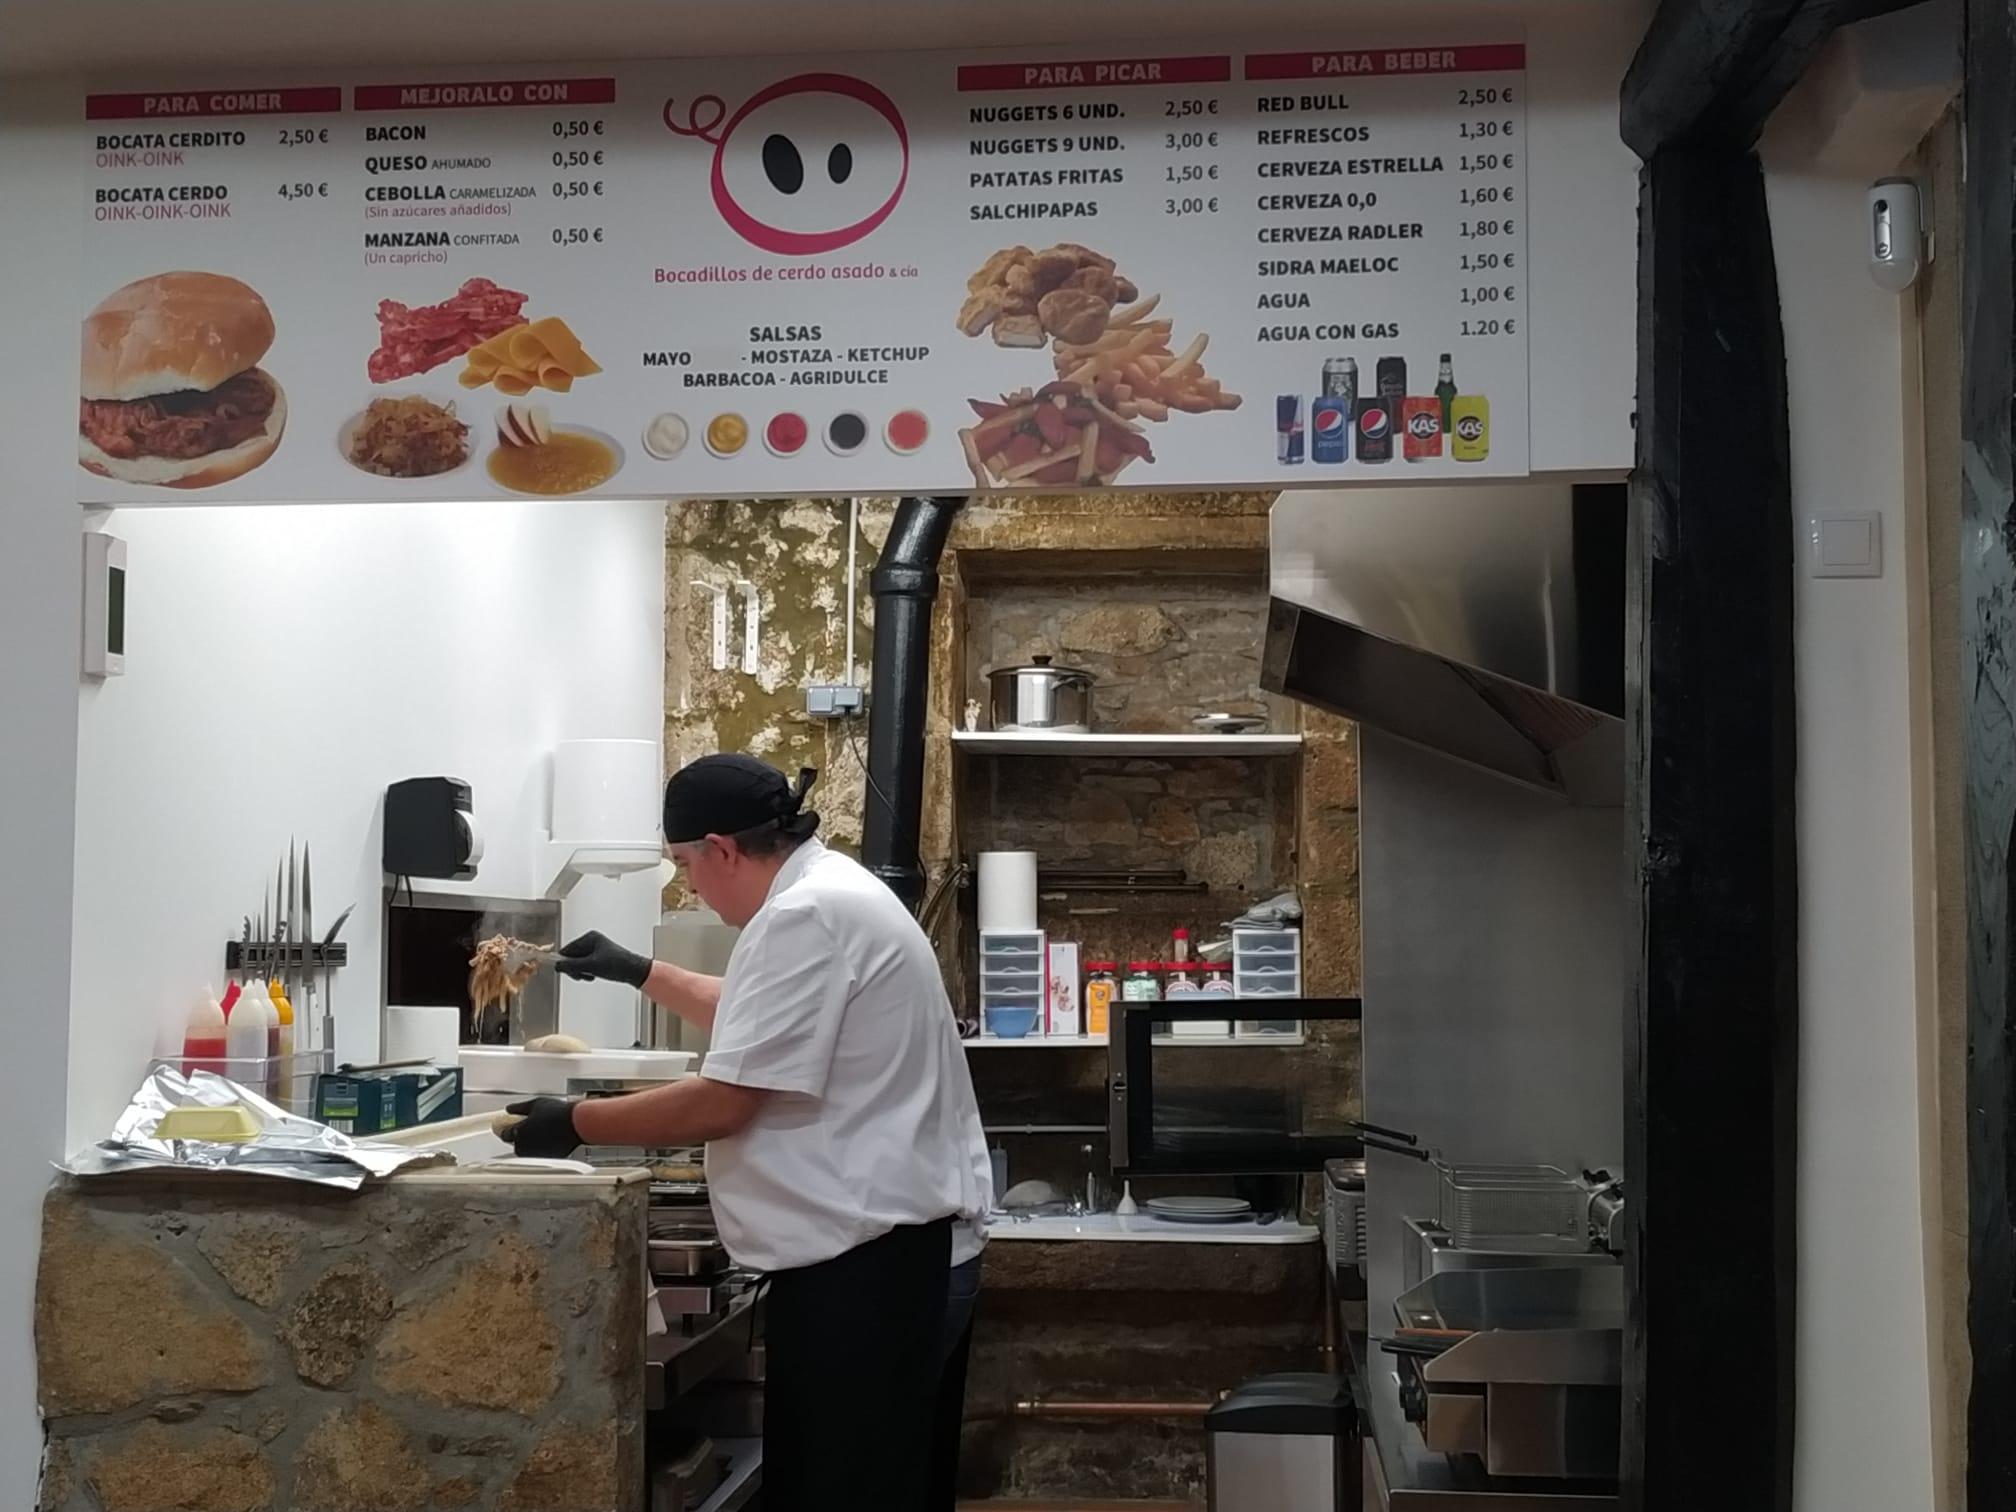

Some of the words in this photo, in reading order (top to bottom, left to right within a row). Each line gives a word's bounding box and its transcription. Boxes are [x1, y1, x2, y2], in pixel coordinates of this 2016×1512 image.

[1313, 55, 1373, 72] PARA
[1385, 51, 1455, 70] BEBER
[1025, 66, 1084, 84] PARA
[1096, 63, 1161, 81] PICAR
[145, 96, 199, 113] PARA
[210, 93, 281, 111] COMER
[401, 86, 513, 104] MEJORALO
[524, 84, 567, 100] CON
[1459, 88, 1496, 107] 2,50
[1502, 88, 1512, 102] €
[1166, 100, 1202, 118] 2,50
[1208, 99, 1218, 114] €
[1258, 97, 1294, 112] RED
[1301, 95, 1348, 110] BULL
[970, 105, 1057, 122] NUGGETS
[1063, 105, 1073, 119] 6
[1079, 104, 1124, 119] UND.
[280, 129, 314, 146] 2,50
[319, 129, 328, 143] €
[366, 126, 425, 141] BACON
[553, 121, 588, 139] 0,50
[593, 120, 603, 135] €
[1258, 127, 1369, 144] REFRESCOS
[1460, 121, 1497, 140] 1,30
[1502, 121, 1512, 135] €
[97, 134, 165, 149] BOCATA
[169, 131, 245, 147] CERDITO
[970, 138, 1058, 155] NUGGETS
[1063, 137, 1073, 151] 9
[1079, 136, 1124, 151] UND.
[1166, 132, 1203, 151] 3,00
[1208, 132, 1218, 146] €
[96, 151, 184, 168] OINK-OINK
[365, 156, 427, 174] QUESO
[431, 158, 491, 169] AHUMADO
[553, 150, 589, 169] 0,50
[593, 150, 603, 165] €
[1258, 160, 1342, 177] CERVEZA
[1348, 157, 1443, 174] ESTRELLA
[1460, 155, 1497, 173] 1,50
[1503, 154, 1512, 168] €
[971, 171, 1052, 187] PATATAS
[1059, 168, 1123, 184] FRITAS
[1167, 166, 1202, 184] 1,50
[1208, 165, 1218, 179] €
[96, 188, 164, 203] BOCATA
[169, 186, 227, 201] CERDO
[278, 183, 313, 200] 4,50
[318, 183, 328, 197] €
[365, 186, 445, 201] CEBOLLA
[450, 184, 536, 199] CARAMELIZADA
[553, 182, 588, 199] 0,50
[593, 182, 603, 195] €
[1461, 188, 1498, 206] 1,60
[1503, 187, 1513, 201] €
[1166, 198, 1203, 216] 3,00
[1208, 197, 1218, 212] €
[1258, 194, 1342, 210] CERVEZA
[1347, 192, 1376, 211] 0,0
[95, 203, 230, 221] OINK-OINK-OINK
[365, 206, 388, 219] (Sin
[392, 203, 446, 216] azúcares
[450, 203, 511, 216] añadidos)
[971, 202, 1097, 220] SALCHIPAPAS
[553, 228, 588, 246] 0,50
[593, 228, 603, 242] €
[1258, 227, 1342, 243] CERVEZA
[1348, 224, 1422, 240] RADLER
[1460, 221, 1498, 239] 1,80
[1503, 220, 1514, 234] €
[365, 232, 450, 247] MANZANA
[454, 234, 519, 245] CONFITADA
[365, 252, 386, 266] (Un
[389, 250, 447, 265] capricho)
[1259, 260, 1315, 276] SIDRA
[1321, 257, 1398, 273] MAELOC
[1461, 254, 1498, 272] 1,50
[1504, 253, 1514, 267] €
[655, 267, 746, 283] Bocadillos
[752, 266, 772, 280] de
[778, 264, 825, 280] cerdo
[832, 263, 884, 278] asado
[889, 268, 897, 277] &
[900, 266, 918, 277] cía
[1258, 293, 1310, 308] AGUA
[1461, 287, 1498, 305] 1,00
[1504, 286, 1514, 300] €
[750, 326, 821, 342] SALSAS
[1258, 326, 1310, 341] AGUA
[1316, 325, 1355, 339] CON
[1362, 323, 1399, 338] GAS
[1461, 320, 1499, 335] 1.20
[1504, 319, 1515, 334] €
[644, 352, 691, 366] MAYO
[752, 349, 832, 364] MOSTAZA
[848, 347, 929, 362] KETCHUP
[684, 373, 775, 387] BARBACOA
[790, 370, 888, 385] AGRIDULCE
[1408, 419, 1439, 433] KAS
[1456, 421, 1483, 434] KAS
